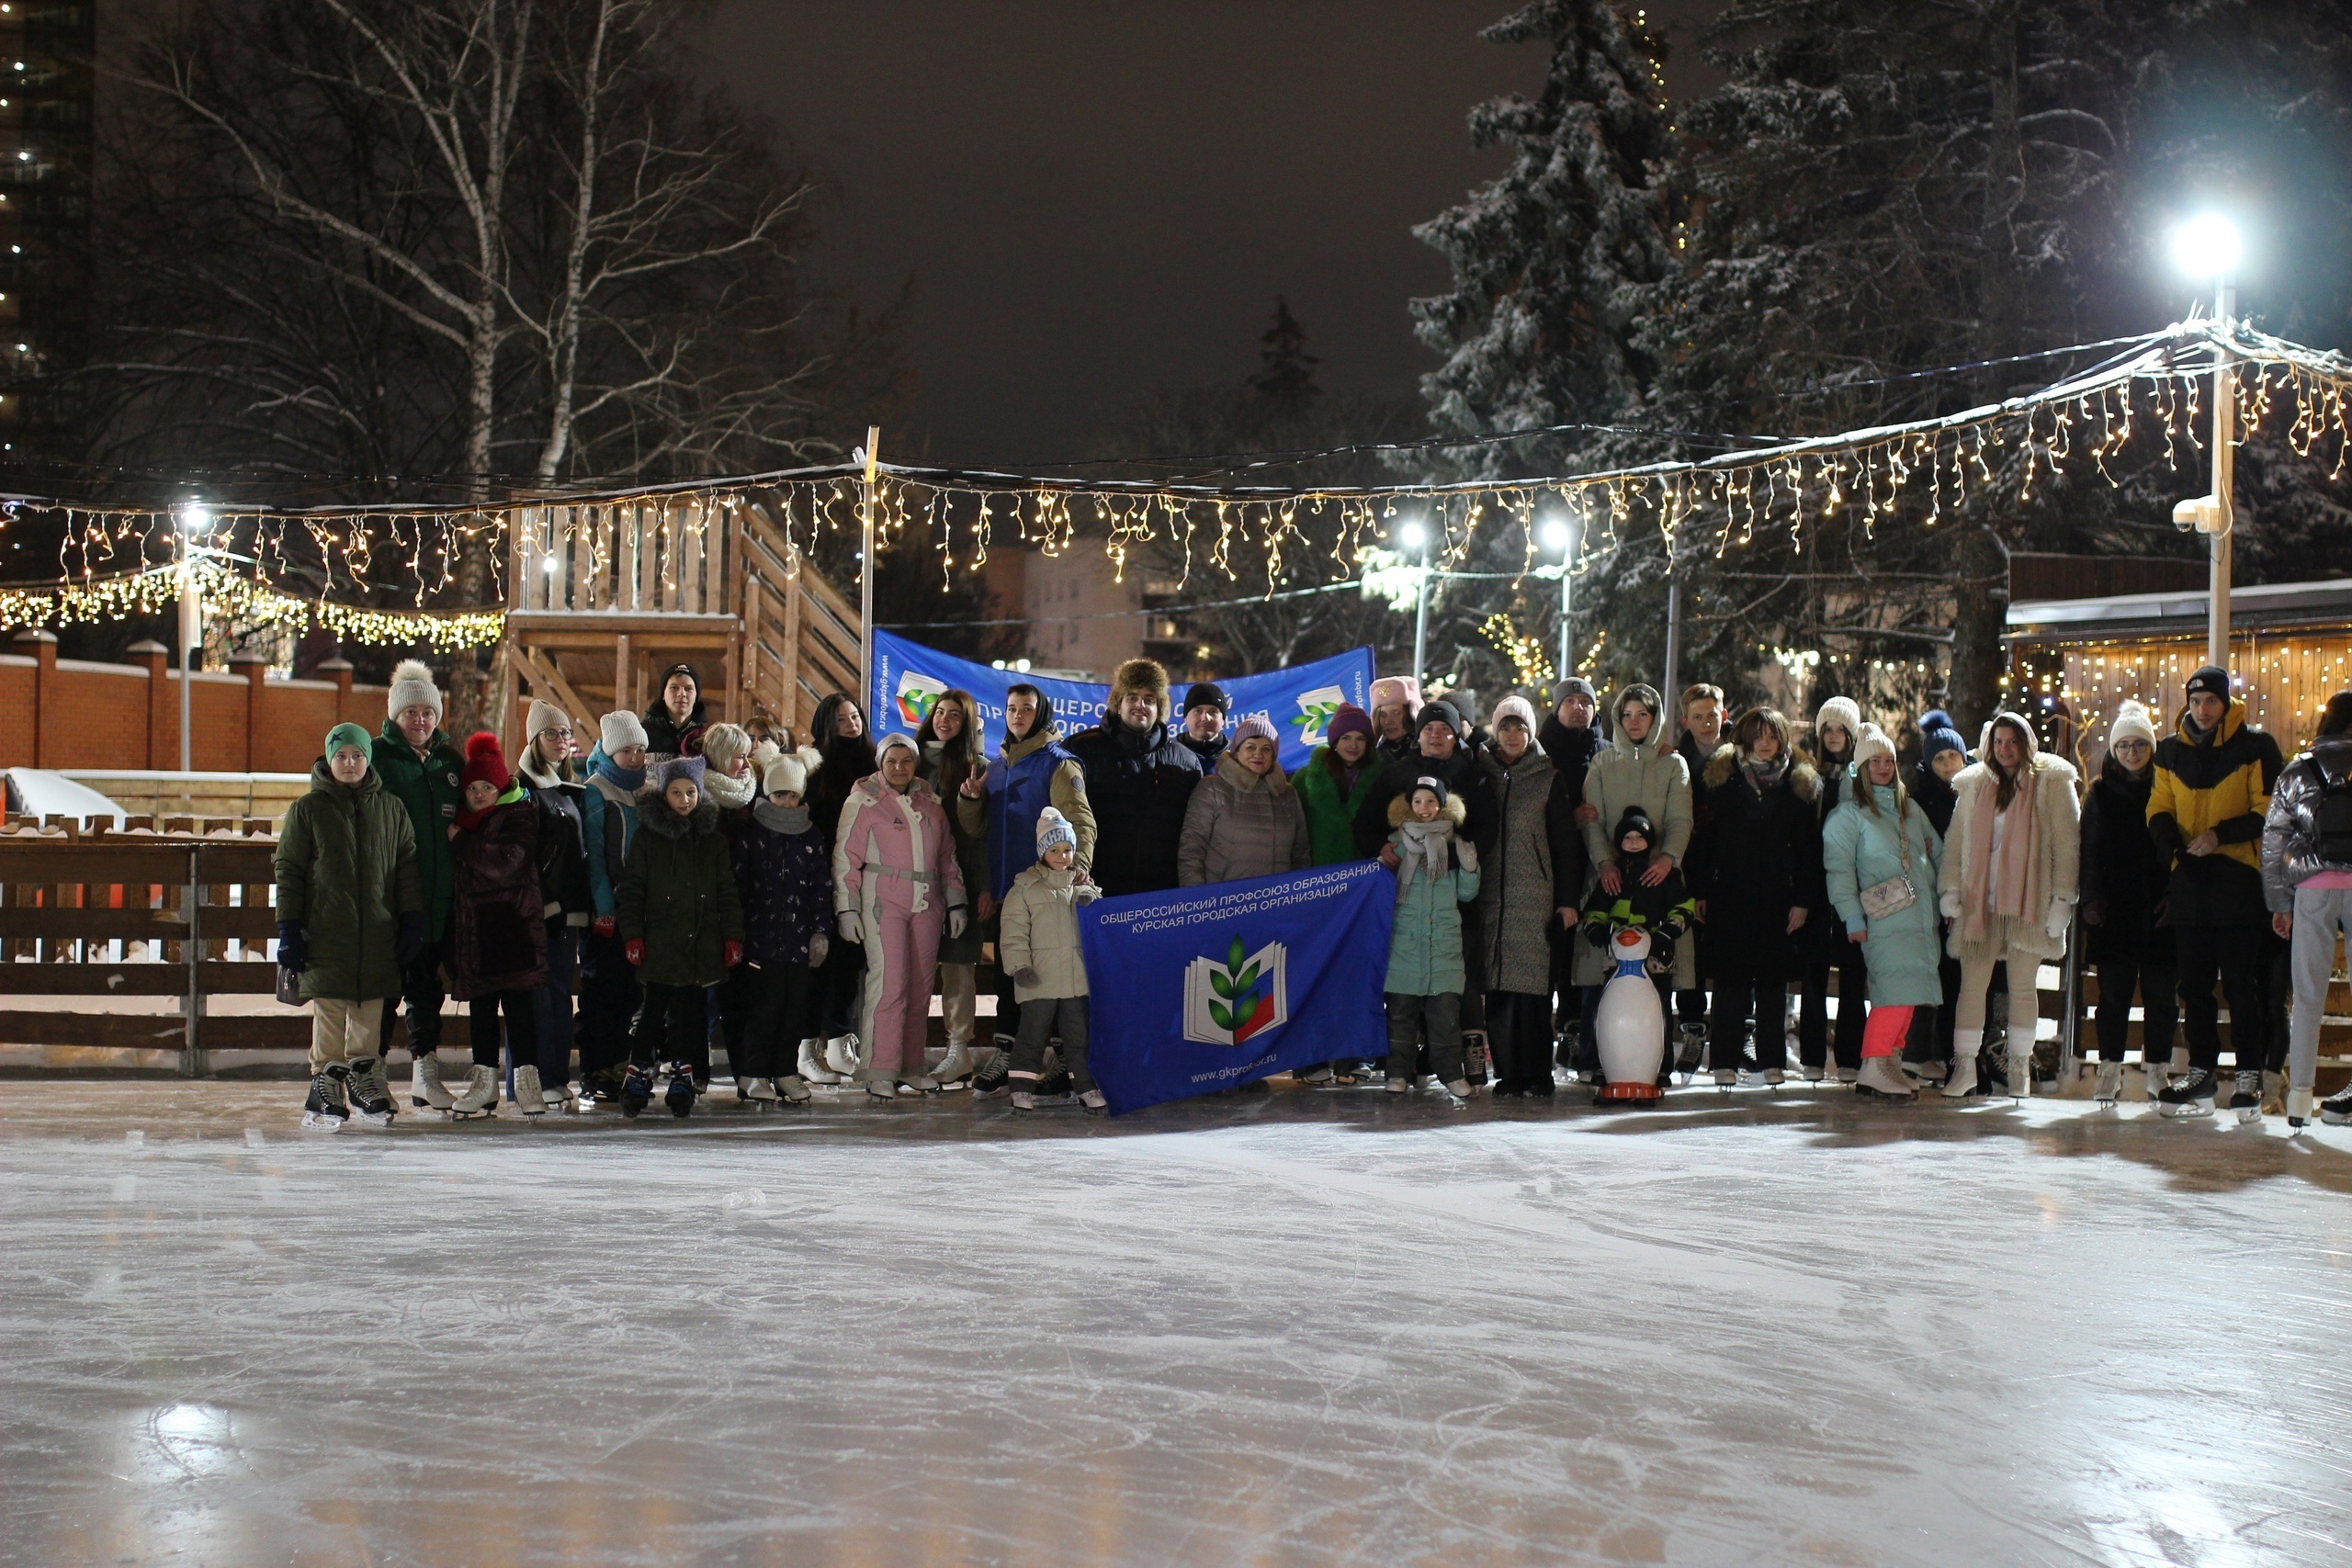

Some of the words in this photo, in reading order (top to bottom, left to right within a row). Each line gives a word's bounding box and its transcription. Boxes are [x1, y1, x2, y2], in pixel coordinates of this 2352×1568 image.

[879, 655, 889, 729] www.gkprofobr.ru
[1100, 897, 1216, 925] ОБЩЕРОССИЙСКИЙ
[1219, 883, 1290, 906] ПРОФСОЮЗ
[1293, 861, 1380, 890] ОБРАЗОВАНИЯ
[1132, 916, 1184, 933] КУРСКАЯ
[1187, 903, 1257, 925] ГОРОДСКАЯ
[1260, 883, 1348, 910] ОРГАНИЗАЦИЯ
